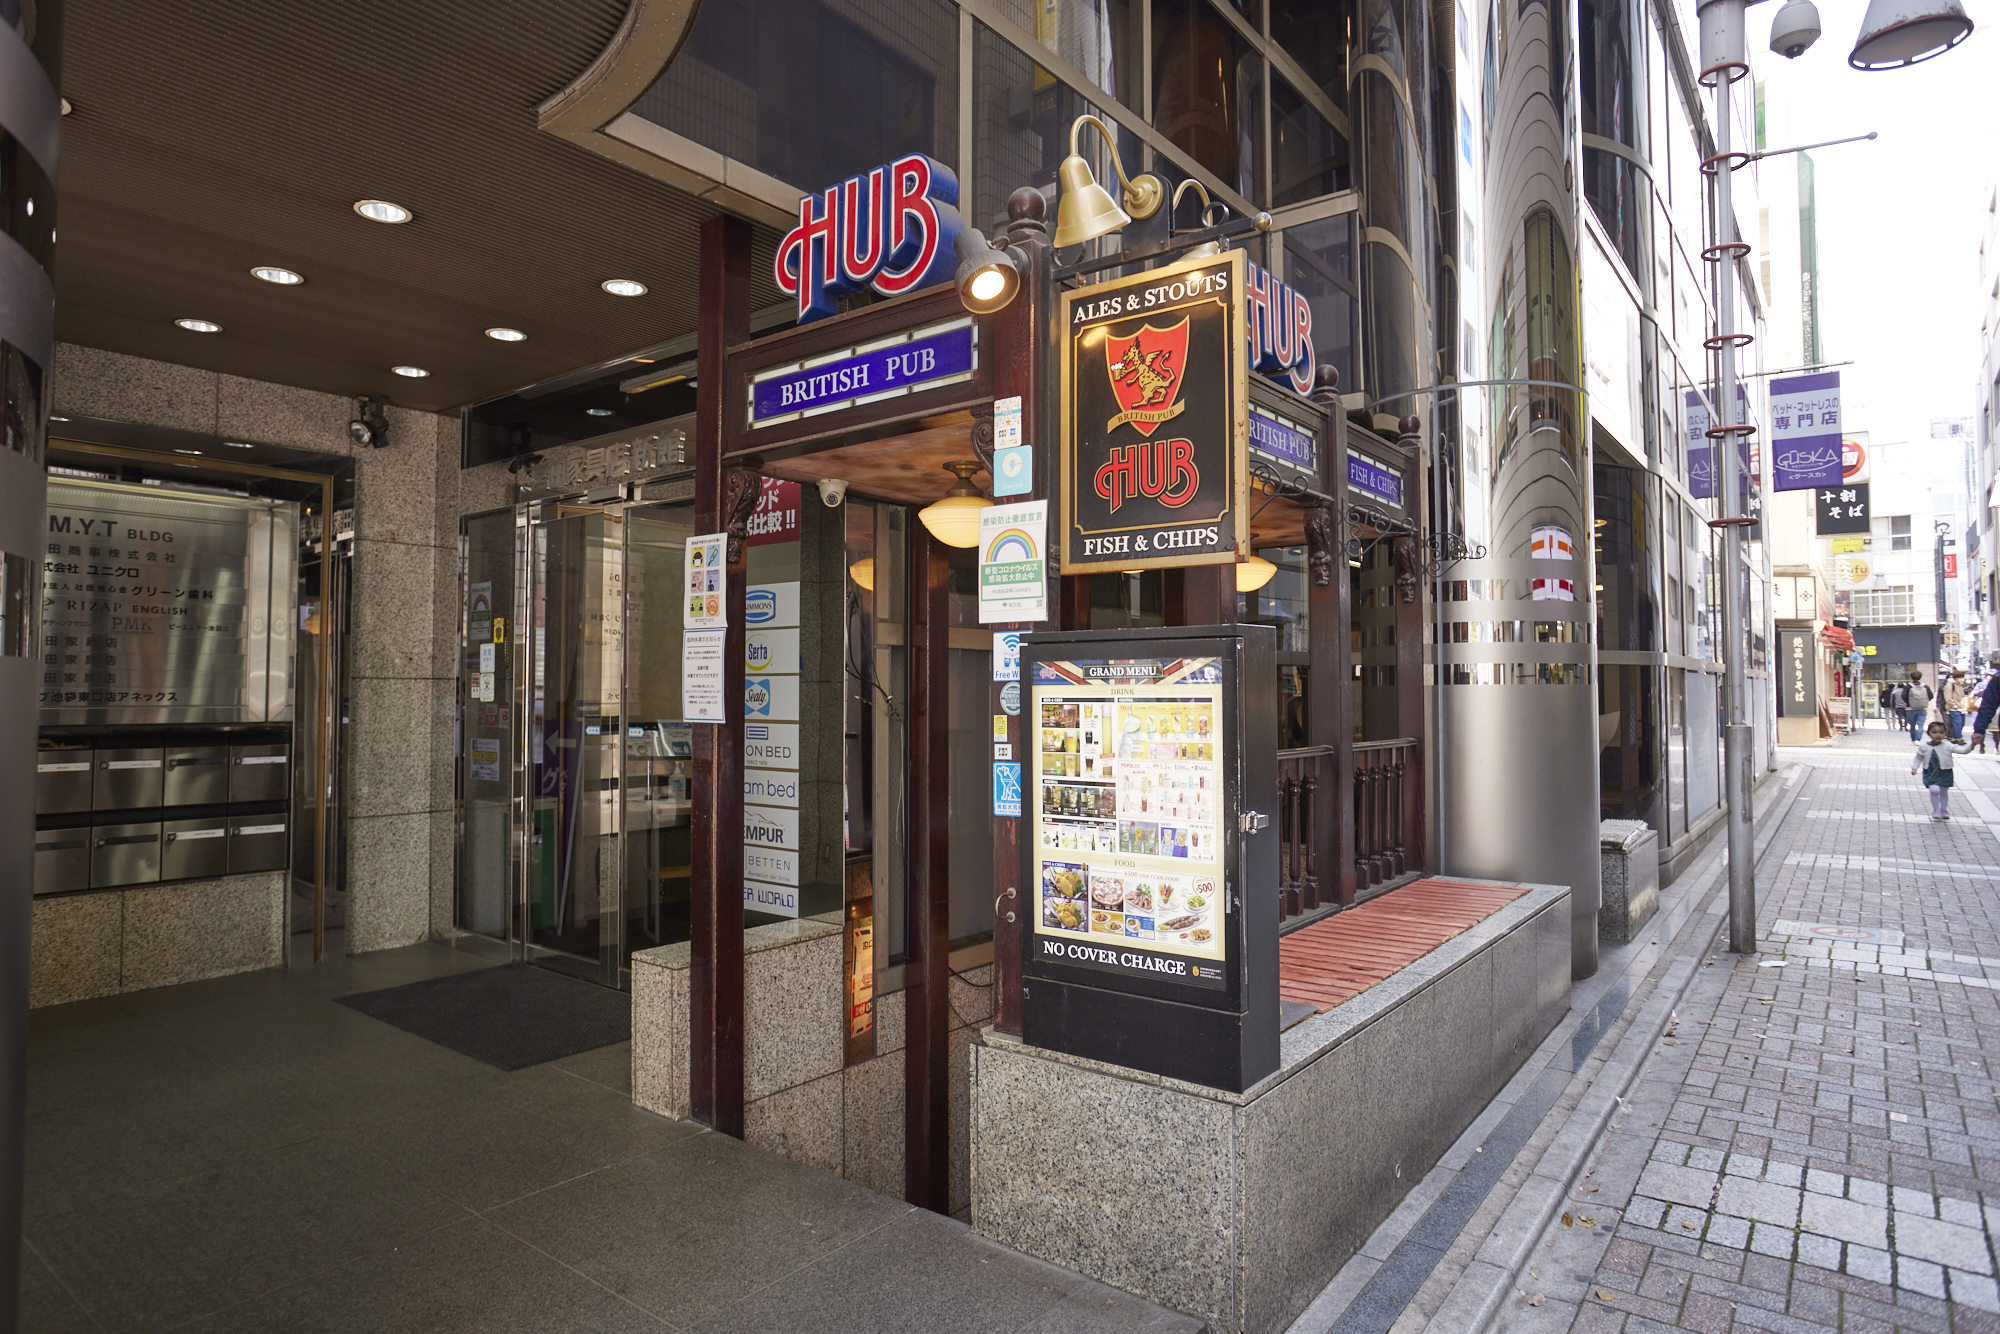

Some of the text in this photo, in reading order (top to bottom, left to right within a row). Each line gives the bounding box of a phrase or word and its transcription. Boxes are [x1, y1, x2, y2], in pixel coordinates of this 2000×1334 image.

[773, 152, 941, 324] HUB
[1074, 271, 1228, 324] ALES & STOUTS
[1247, 259, 1316, 397] HUB
[780, 347, 936, 407] BRITISH PUB
[1117, 409, 1175, 424] BRITISH PUB
[1774, 411, 1837, 430] 専門店
[1249, 418, 1310, 461] RITISH PUB
[1094, 437, 1200, 515] HUB
[1350, 462, 1398, 497] FISH & CHIPS
[1820, 489, 1857, 504] 十割
[982, 511, 1043, 527] 感染防止徹底宣言
[1828, 503, 1865, 519] そば
[49, 514, 174, 543] M.Y.T BLDG
[1084, 526, 1219, 556] FISH & CHIPS
[87, 564, 139, 578] ユニクロ
[984, 562, 1039, 576] 新型コロナウイルス
[988, 572, 1035, 584] 感染拡大防止中
[67, 600, 188, 616] RIZAP ENGLISH
[111, 616, 153, 631] PMK
[45, 635, 118, 648] 田家具店
[748, 643, 768, 660] Serta
[45, 654, 117, 666] 田家具店
[44, 672, 116, 684] 田家具店
[995, 671, 1011, 679] Free
[1089, 666, 1157, 677] GRAND MENU
[765, 745, 791, 759] BED
[767, 779, 795, 799] bed
[748, 855, 791, 871] BETTEN
[1114, 859, 1136, 868] FOOD
[757, 889, 794, 909] WORLD
[1043, 940, 1065, 957] NO
[1068, 944, 1119, 966] COVER
[1121, 952, 1187, 976] CHARGE
